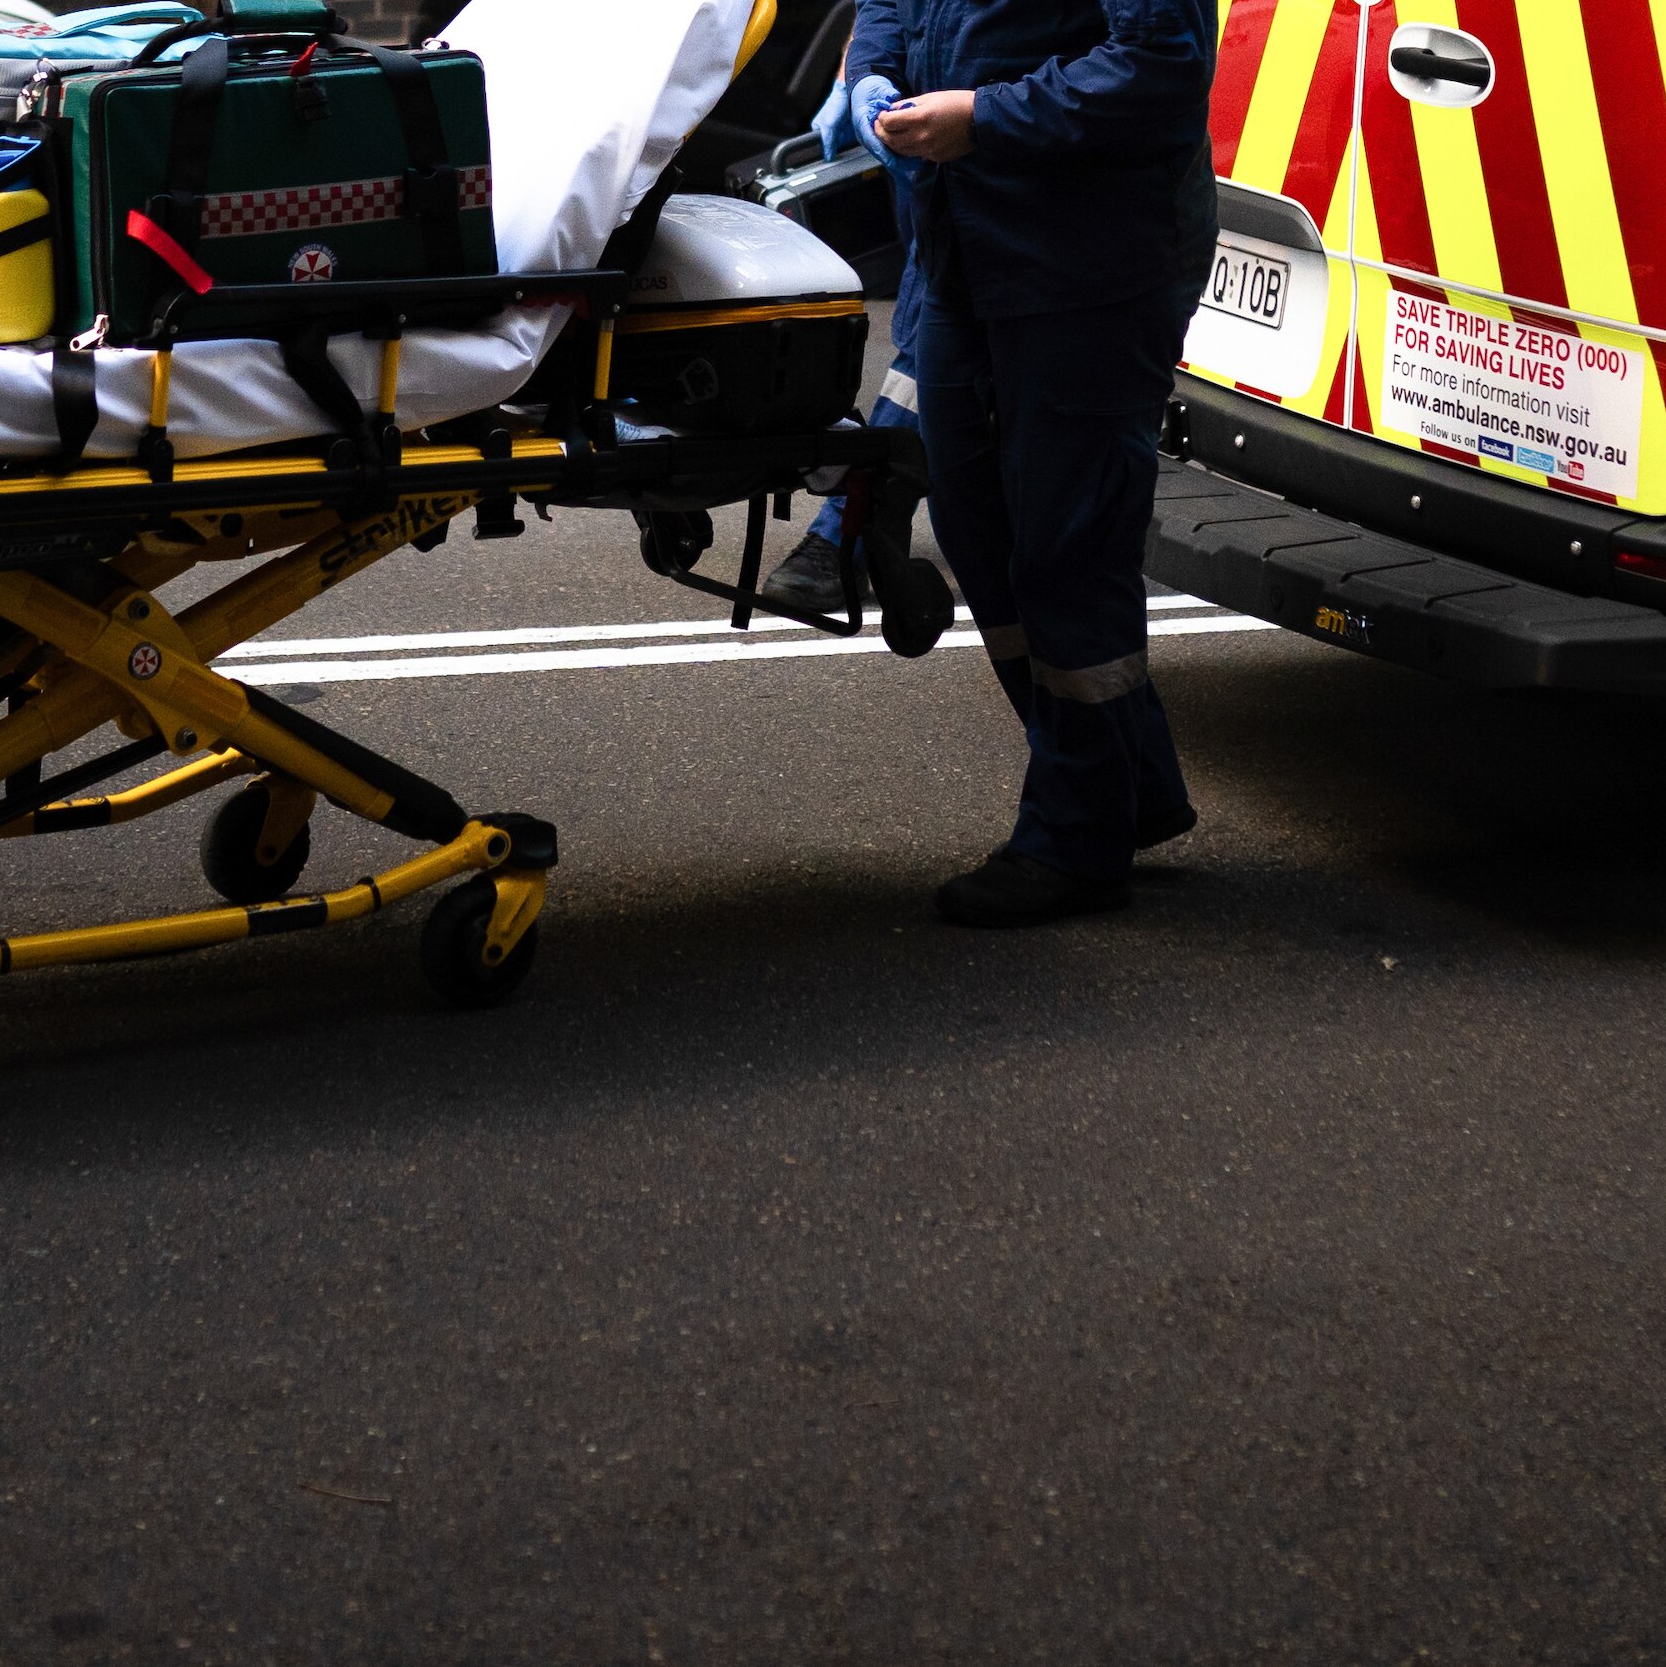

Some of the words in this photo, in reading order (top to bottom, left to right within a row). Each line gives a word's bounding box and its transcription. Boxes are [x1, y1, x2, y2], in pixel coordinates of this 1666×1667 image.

[629, 276, 668, 291] UCAS
[1395, 324, 1429, 353] FOR
[1435, 335, 1503, 374] SAVING
[1509, 355, 1565, 390] LIVES
[1396, 296, 1441, 328] SAVE
[1446, 309, 1510, 347] TRIPLE
[1515, 328, 1571, 362] ZERO
[1577, 342, 1628, 381] (000)
[1391, 384, 1627, 466] www.ambulance.nsw.gov.au
[1393, 354, 1416, 376] For
[1420, 369, 1457, 391] more
[1462, 374, 1551, 417] information
[1556, 401, 1591, 427] visit
[1420, 421, 1449, 440] Follow
[1451, 433, 1463, 446] us
[1464, 437, 1476, 449] on
[1481, 439, 1511, 457] facebook
